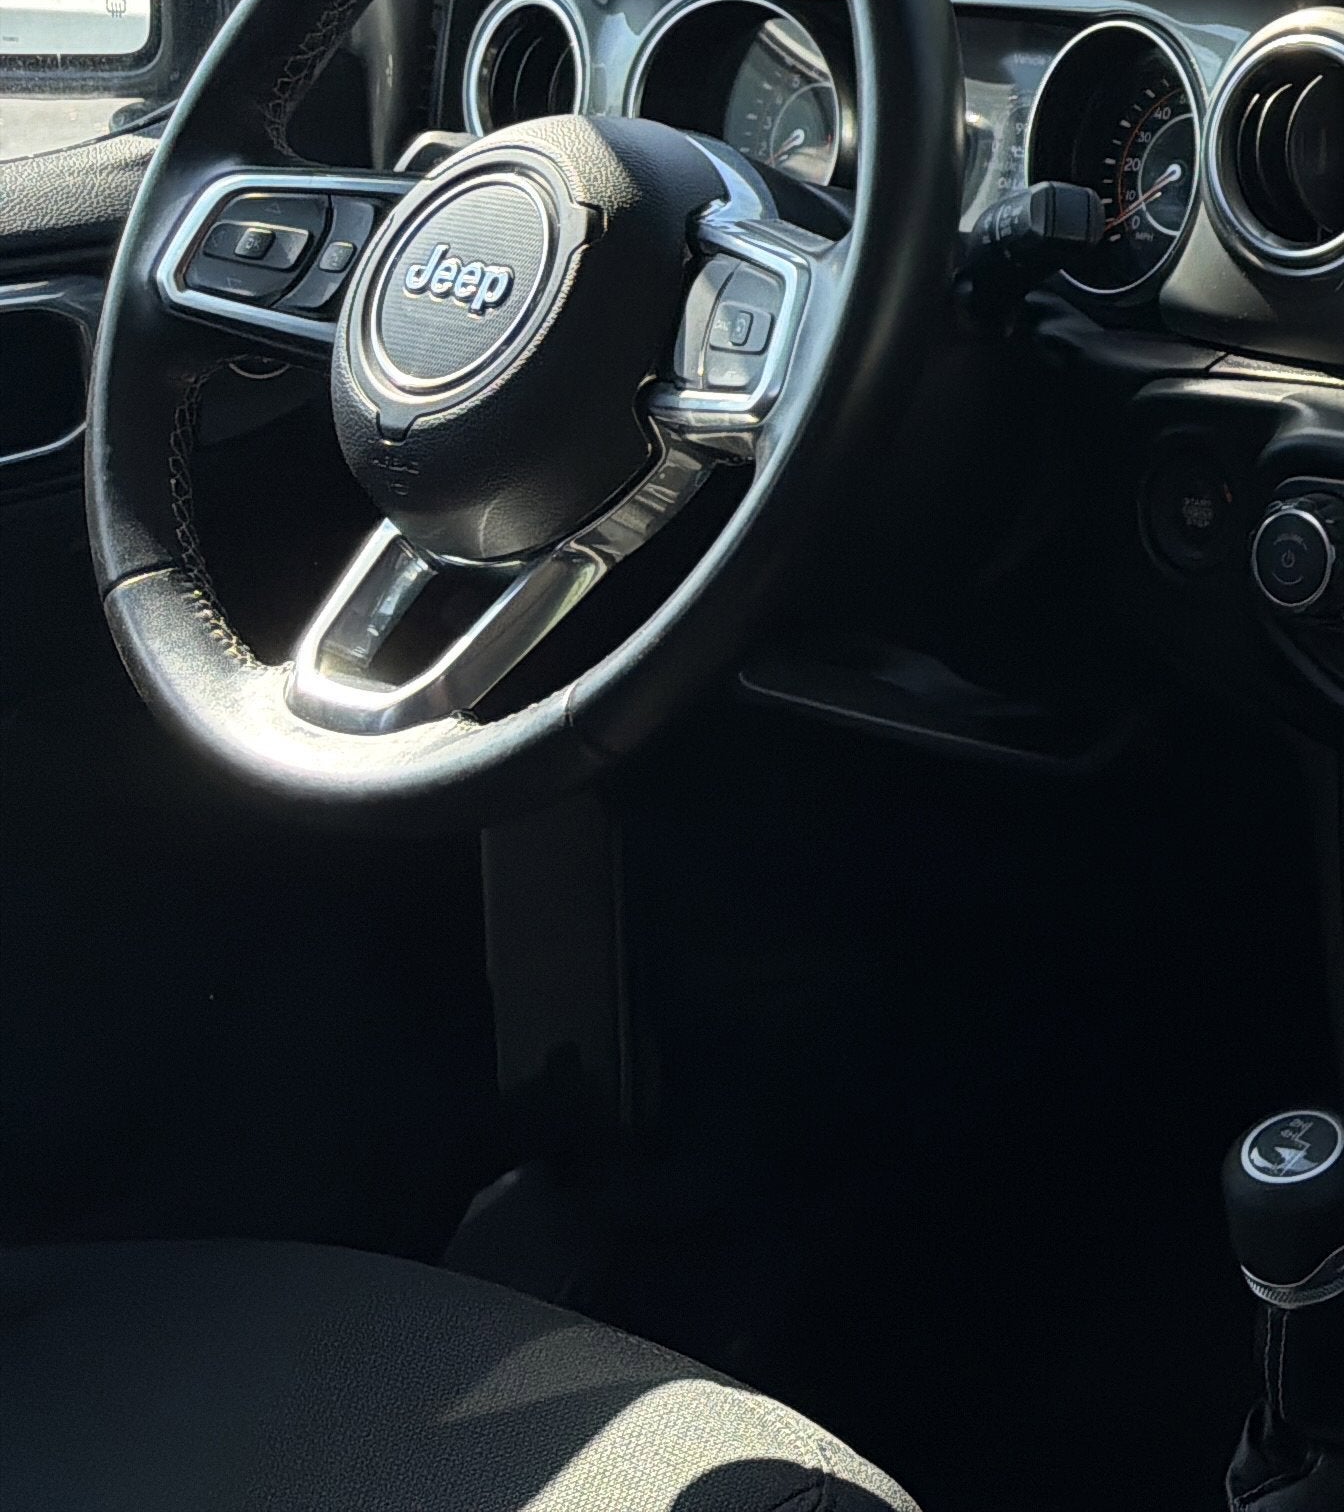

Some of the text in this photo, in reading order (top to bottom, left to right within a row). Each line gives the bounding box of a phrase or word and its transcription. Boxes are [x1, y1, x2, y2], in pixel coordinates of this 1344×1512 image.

[1153, 107, 1172, 120] 40
[1137, 131, 1151, 143] 30
[1124, 157, 1141, 172] 20
[1125, 190, 1136, 201] 10
[1131, 216, 1140, 229] 0
[404, 242, 515, 316] Jeep
